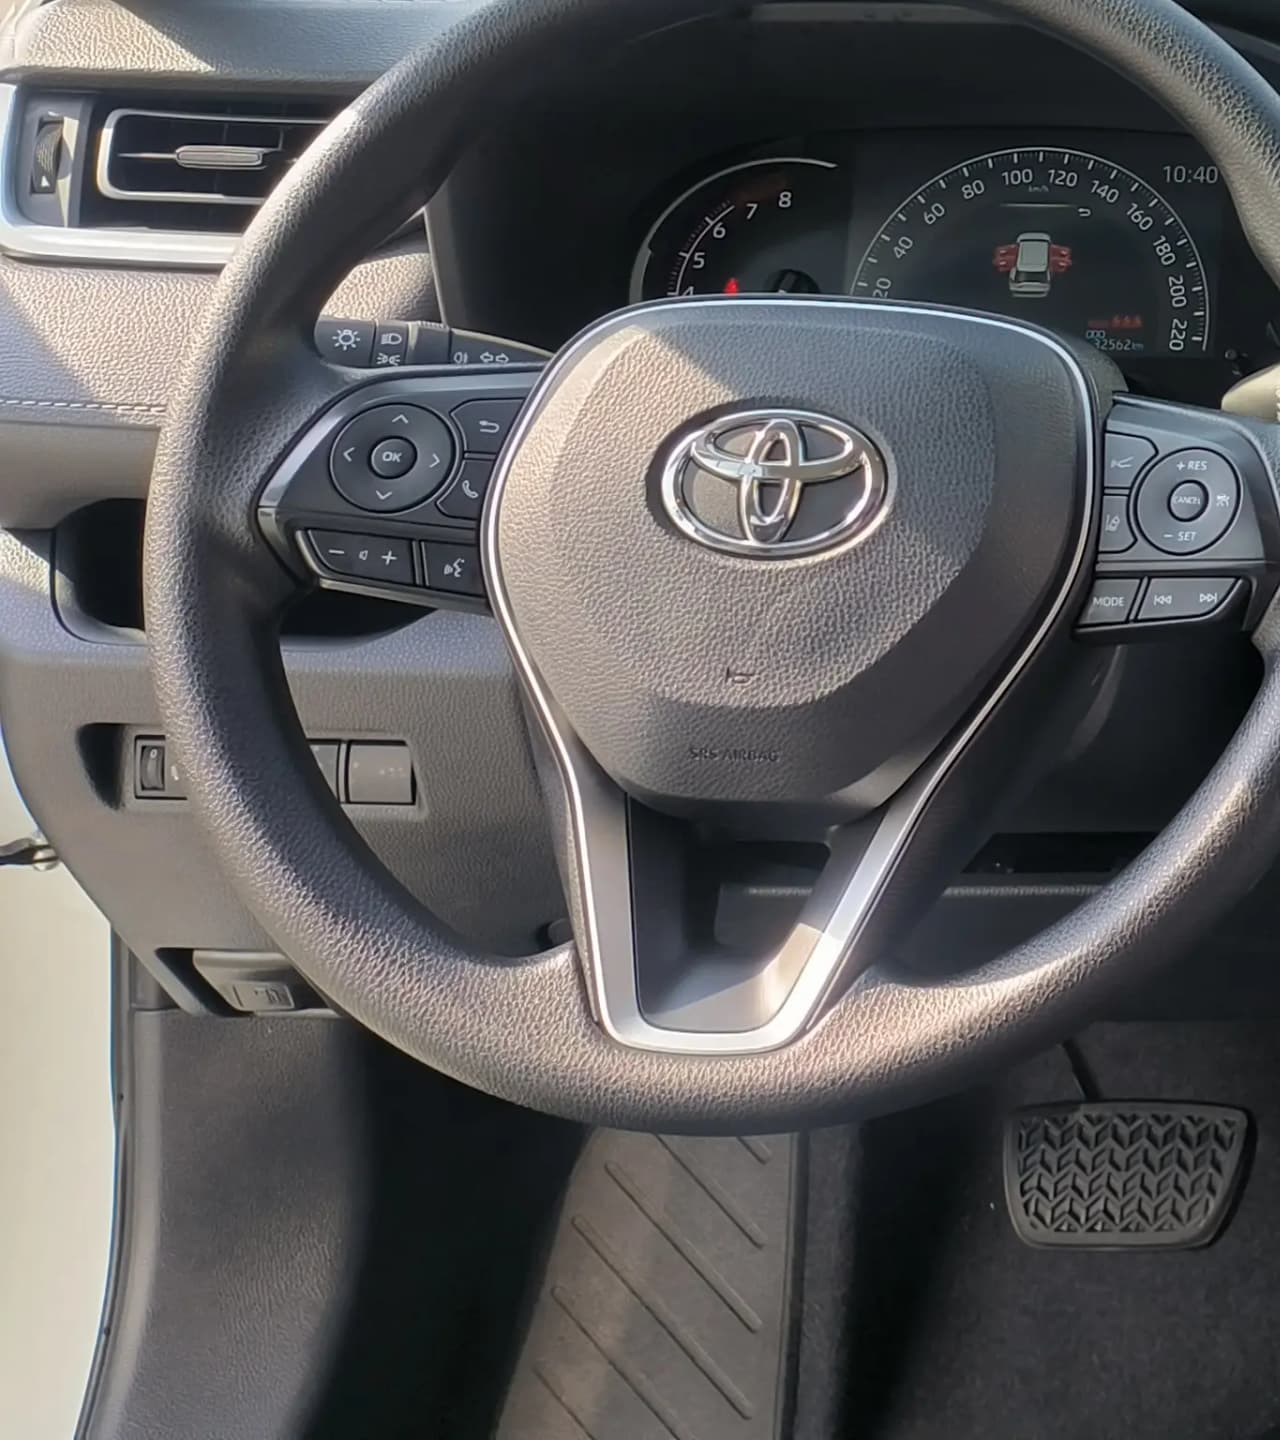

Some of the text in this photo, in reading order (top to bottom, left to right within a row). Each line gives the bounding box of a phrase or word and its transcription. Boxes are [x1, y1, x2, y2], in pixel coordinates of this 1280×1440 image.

[1001, 169, 1033, 186] 100
[1048, 169, 1078, 188] 120
[1163, 165, 1219, 184] 10:40
[961, 179, 985, 200] 80
[1090, 180, 1120, 204] 140
[778, 191, 792, 208] 8
[746, 203, 758, 220] 7
[923, 202, 945, 225] 60
[1126, 203, 1154, 231] 160
[712, 222, 726, 239] 6
[893, 236, 914, 259] 40
[1152, 234, 1177, 266] 180
[692, 252, 705, 268] 5
[872, 277, 892, 298] 20
[1168, 274, 1188, 308] 200
[1168, 318, 1188, 352] 220
[381, 450, 402, 465] OK
[1177, 531, 1197, 542] SET
[1092, 596, 1125, 607] MODE
